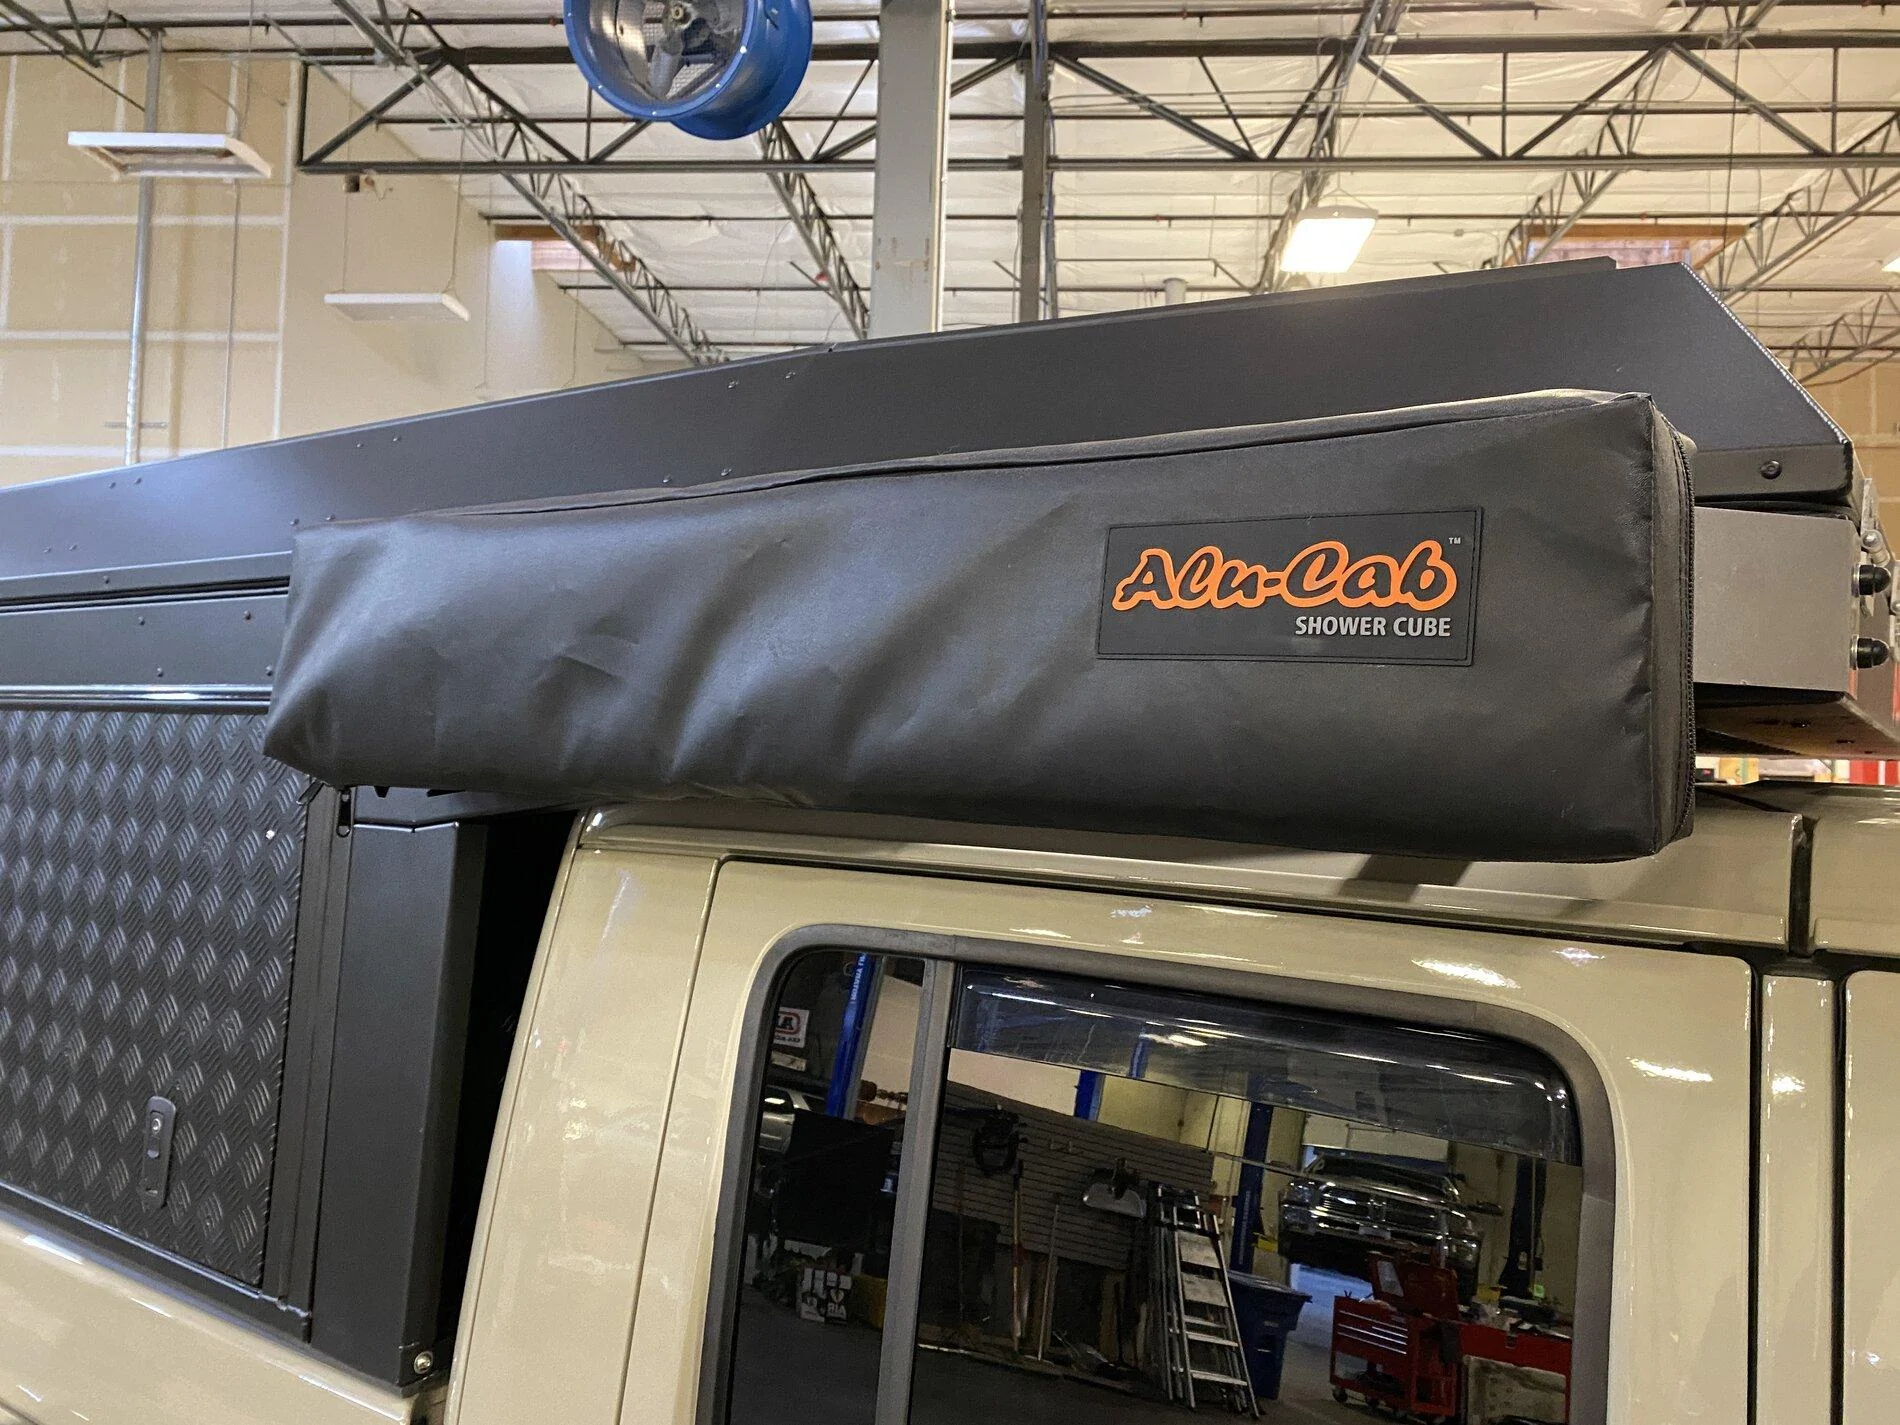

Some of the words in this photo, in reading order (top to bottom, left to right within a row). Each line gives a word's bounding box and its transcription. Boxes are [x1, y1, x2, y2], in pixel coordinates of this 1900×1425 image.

[1112, 540, 1457, 611] Alu-Cab
[1448, 537, 1461, 545] TM
[1295, 616, 1386, 636] SHOWER
[1393, 617, 1451, 637] CUBE
